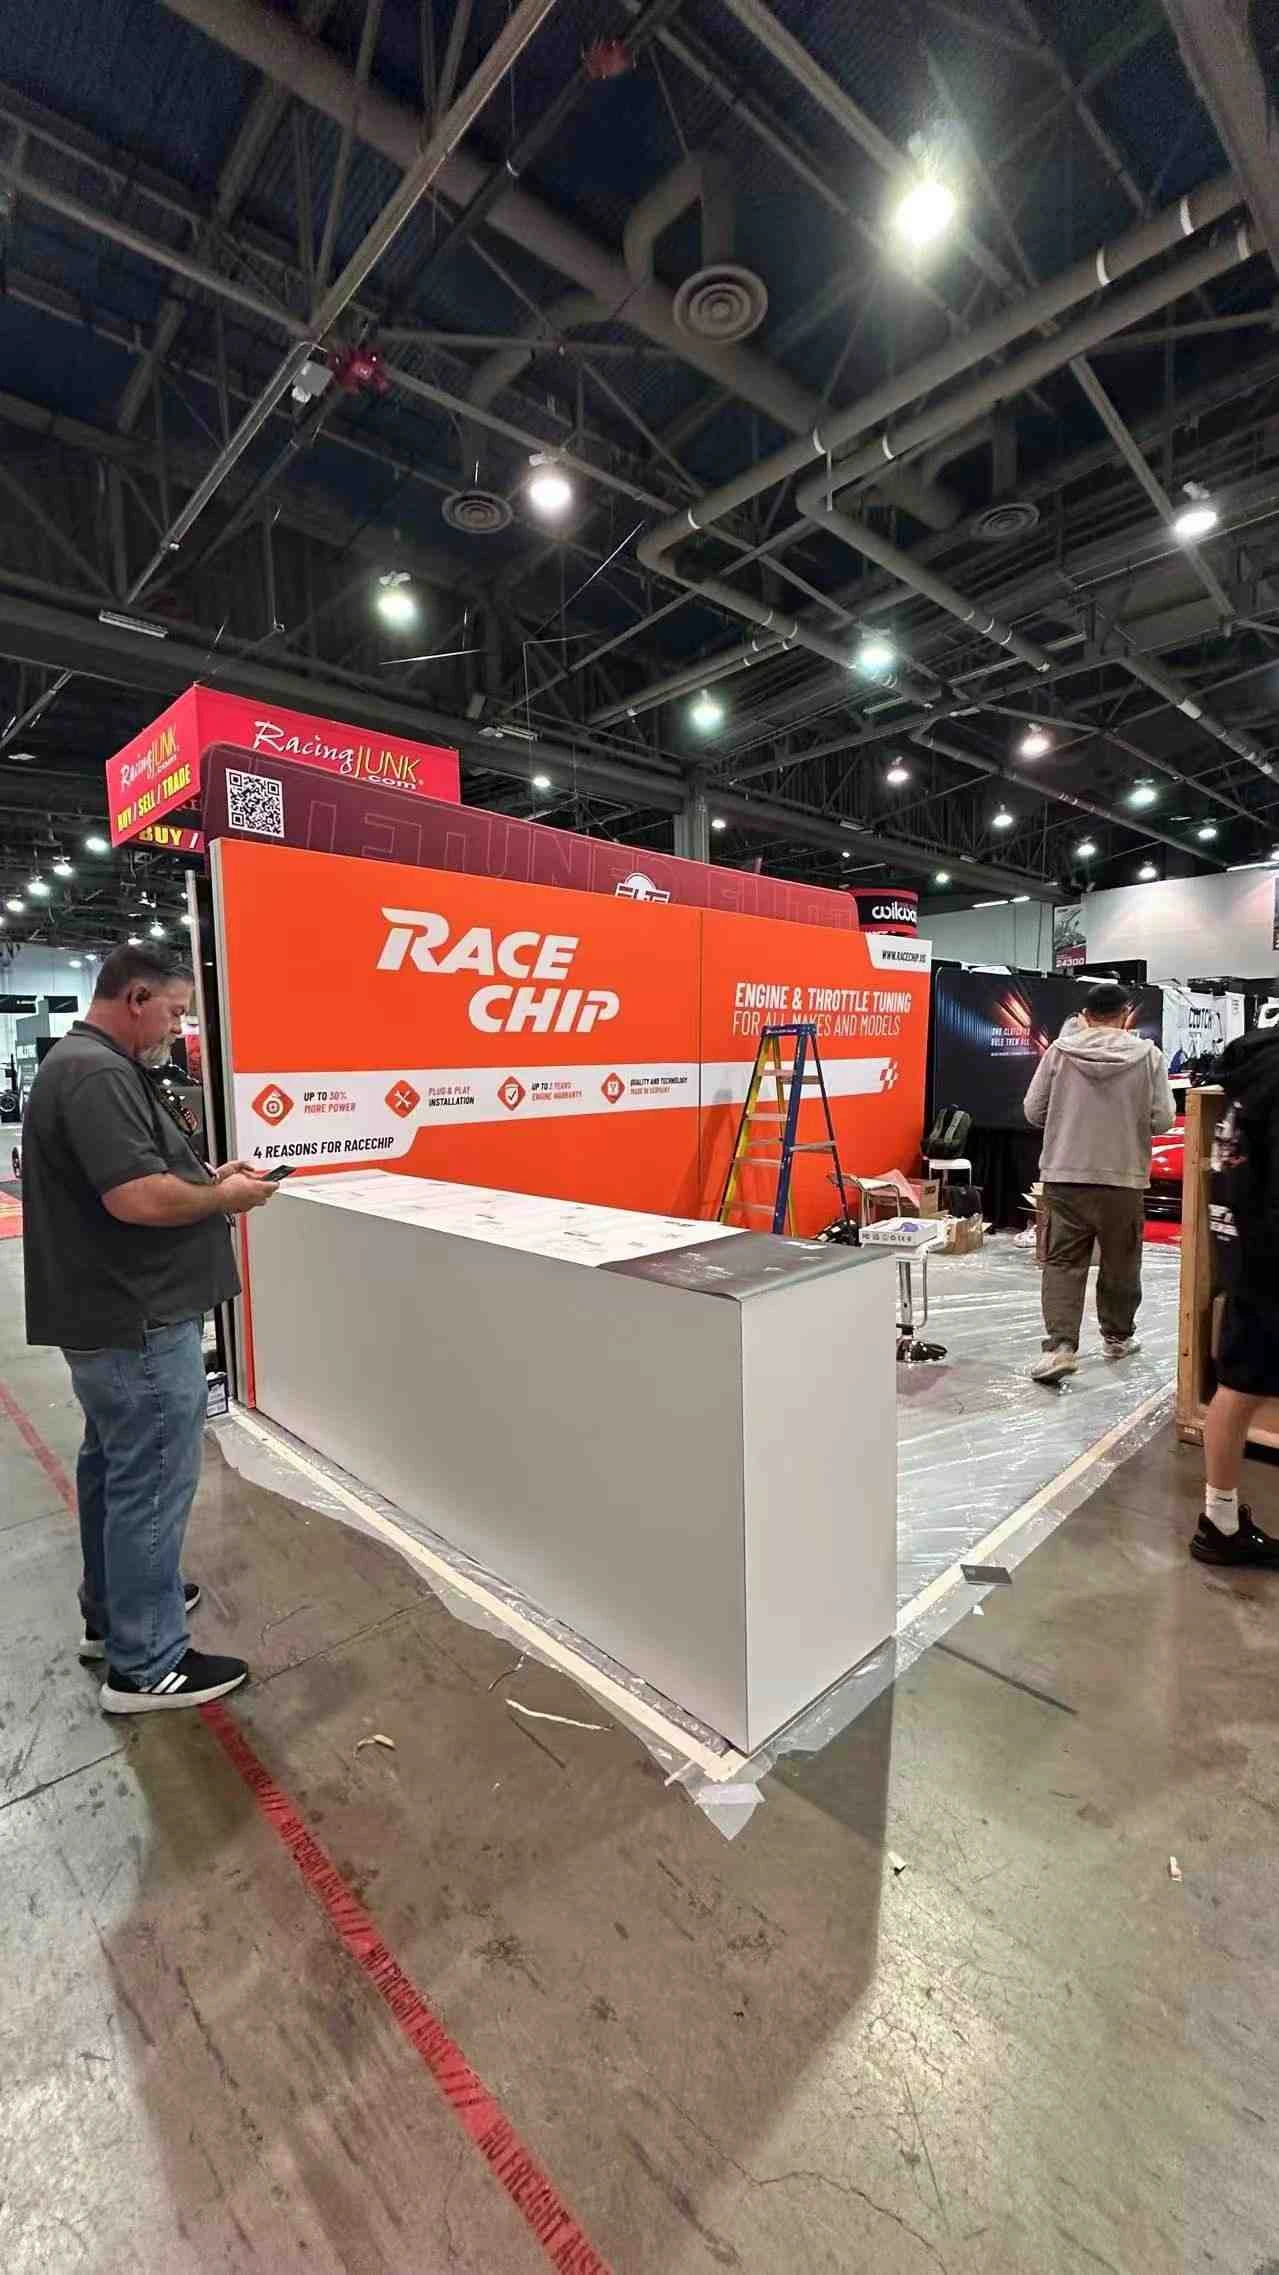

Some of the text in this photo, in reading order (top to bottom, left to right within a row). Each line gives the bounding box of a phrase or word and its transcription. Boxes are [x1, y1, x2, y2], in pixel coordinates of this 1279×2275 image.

[138, 789, 156, 817] SELL
[162, 763, 191, 800] TRADE
[376, 907, 580, 981] RACE
[468, 984, 621, 1033] CHIP
[735, 982, 913, 1013] ENGINE & THROTTLE TUNING
[732, 1010, 761, 1037] FOR
[833, 1015, 857, 1037] AND
[860, 1015, 902, 1037] MODELS
[429, 1087, 447, 1096] PLUG
[454, 1086, 471, 1095] PLAY
[531, 1082, 540, 1091] UP
[541, 1082, 549, 1090] TO
[630, 1076, 688, 1086] QUALITY AND TECHNOLOGY
[304, 1091, 315, 1103] UP
[317, 1091, 328, 1102] TO
[304, 1102, 357, 1114] MORE POWER
[429, 1096, 475, 1107] INSTALLATION
[253, 1136, 395, 1159] 4 REASONS FOR RACECHIP
[373, 1962, 427, 2025] FREIGHT
[477, 2114, 513, 2161] NO
[497, 2147, 570, 2245] FREIGHT
